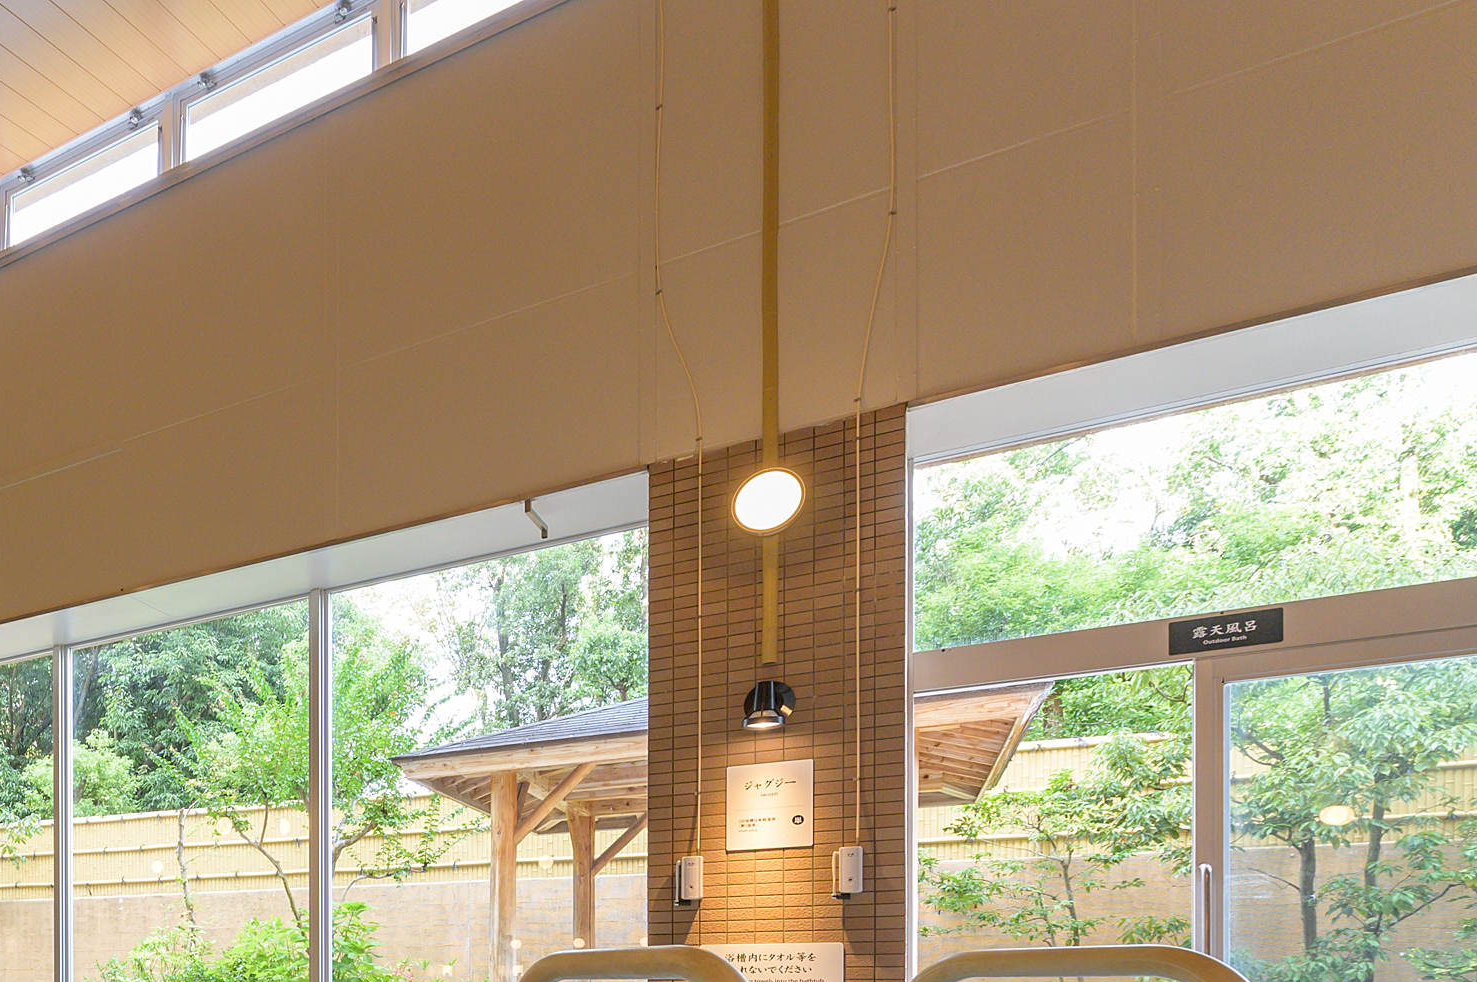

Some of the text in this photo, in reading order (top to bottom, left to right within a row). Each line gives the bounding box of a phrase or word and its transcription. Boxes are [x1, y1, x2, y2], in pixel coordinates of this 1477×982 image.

[1192, 620, 1257, 639] 露天風呂
[1203, 634, 1248, 645] Outdoor Bath
[744, 777, 796, 791] ジャグジー
[725, 952, 816, 962] 浴槽内にタオル等を
[740, 965, 812, 974] れないでください
